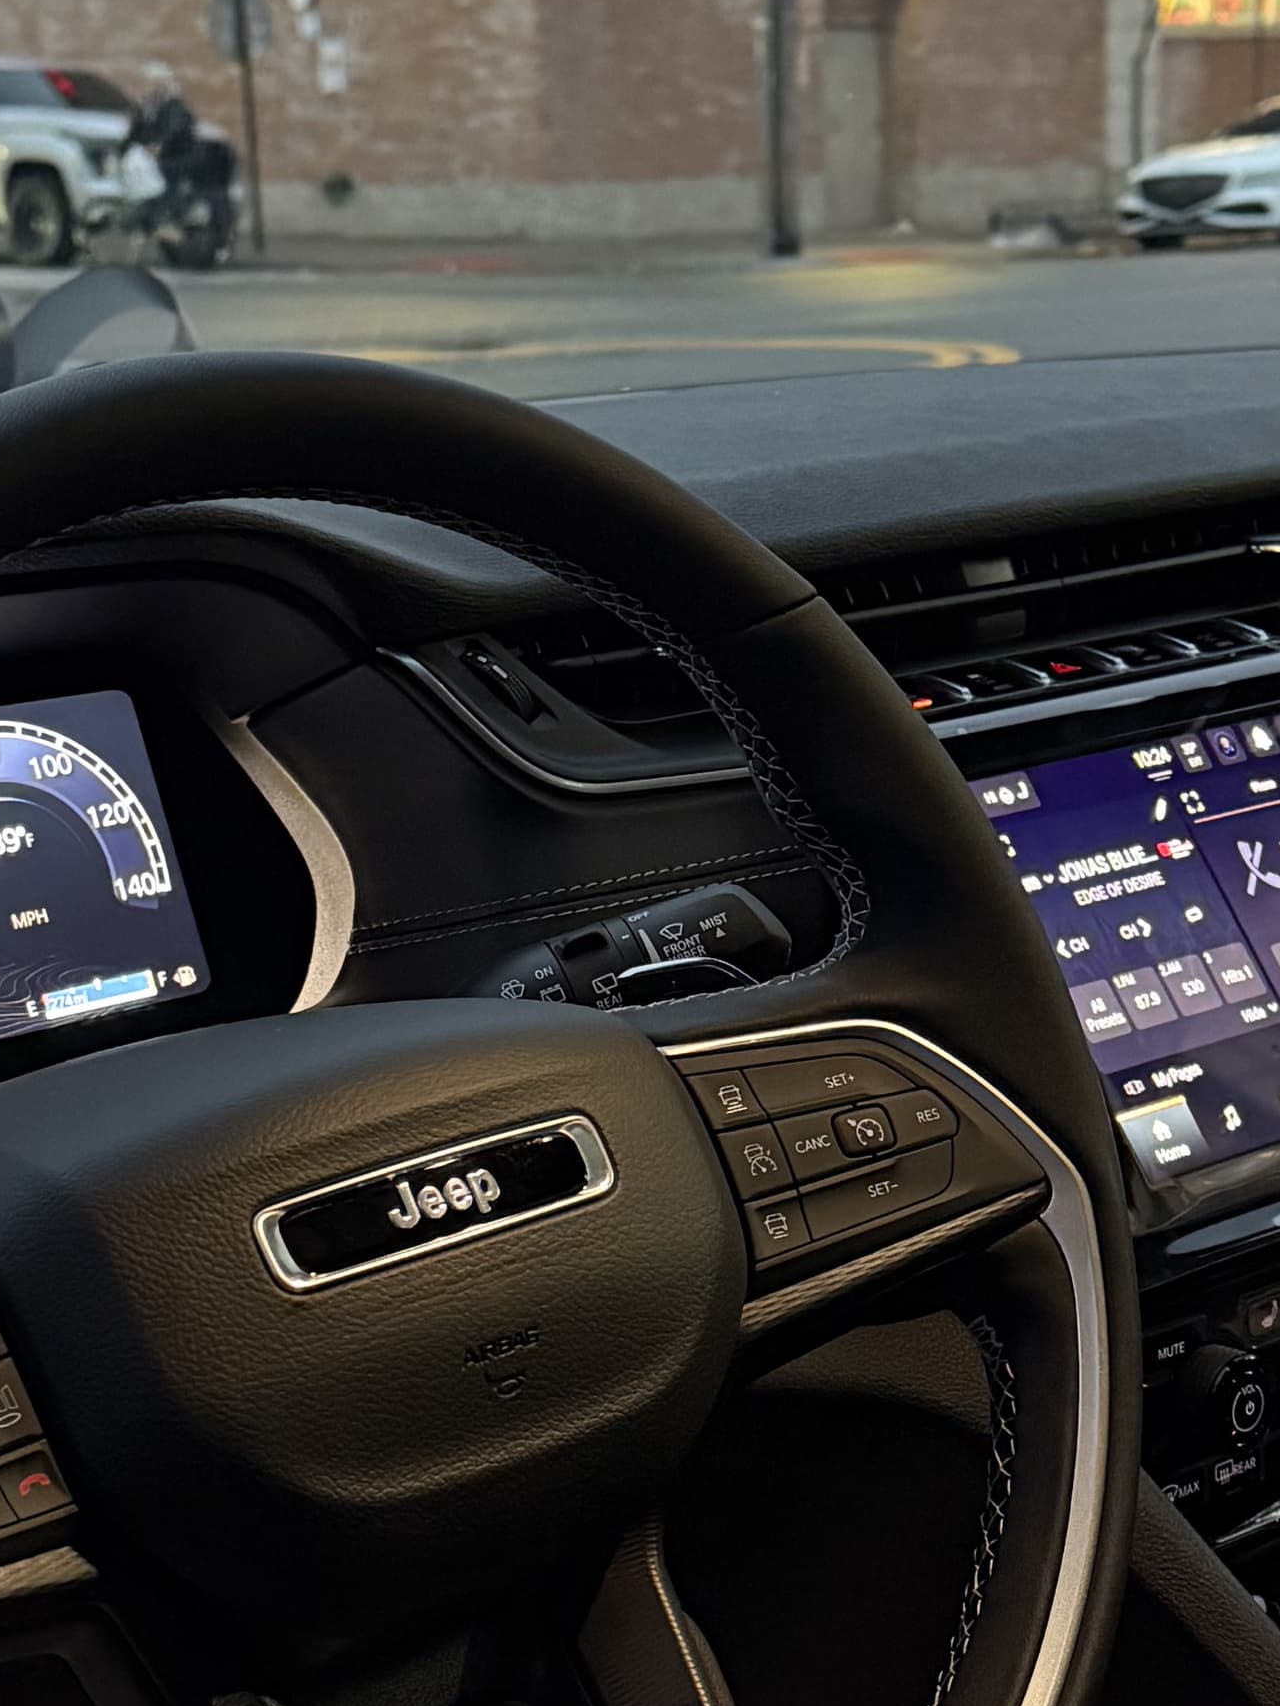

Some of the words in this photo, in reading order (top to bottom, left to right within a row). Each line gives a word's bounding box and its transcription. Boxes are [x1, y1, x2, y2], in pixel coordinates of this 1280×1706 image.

[28, 752, 72, 780] 100
[1132, 746, 1172, 768] 10:24
[86, 799, 129, 828] 120
[1058, 855, 1111, 884] JONAS
[114, 871, 157, 902] 140
[1074, 887, 1106, 906] EDGE
[1107, 882, 1124, 899] OF
[1123, 872, 1166, 897] DESIRE
[10, 907, 49, 931] MPH
[699, 912, 729, 932] MIST
[1119, 924, 1139, 940] CH
[662, 933, 702, 957] FRONT
[1070, 937, 1089, 953] CH
[534, 966, 555, 981] ON
[26, 1000, 39, 1018] E
[157, 971, 168, 988] F
[1135, 992, 1161, 1009] 87.9
[1090, 999, 1107, 1014] All
[1086, 1011, 1126, 1033] Presets
[824, 1073, 856, 1090] SET+
[1169, 1062, 1203, 1088] Pages
[916, 1107, 940, 1124] RES
[795, 1134, 832, 1155] CANC
[1154, 1142, 1191, 1164] Home
[387, 1167, 501, 1230] Jeep
[462, 1324, 540, 1366] AIRBAG
[1157, 1341, 1186, 1361] MUTE
[1177, 1480, 1201, 1499] MAX
